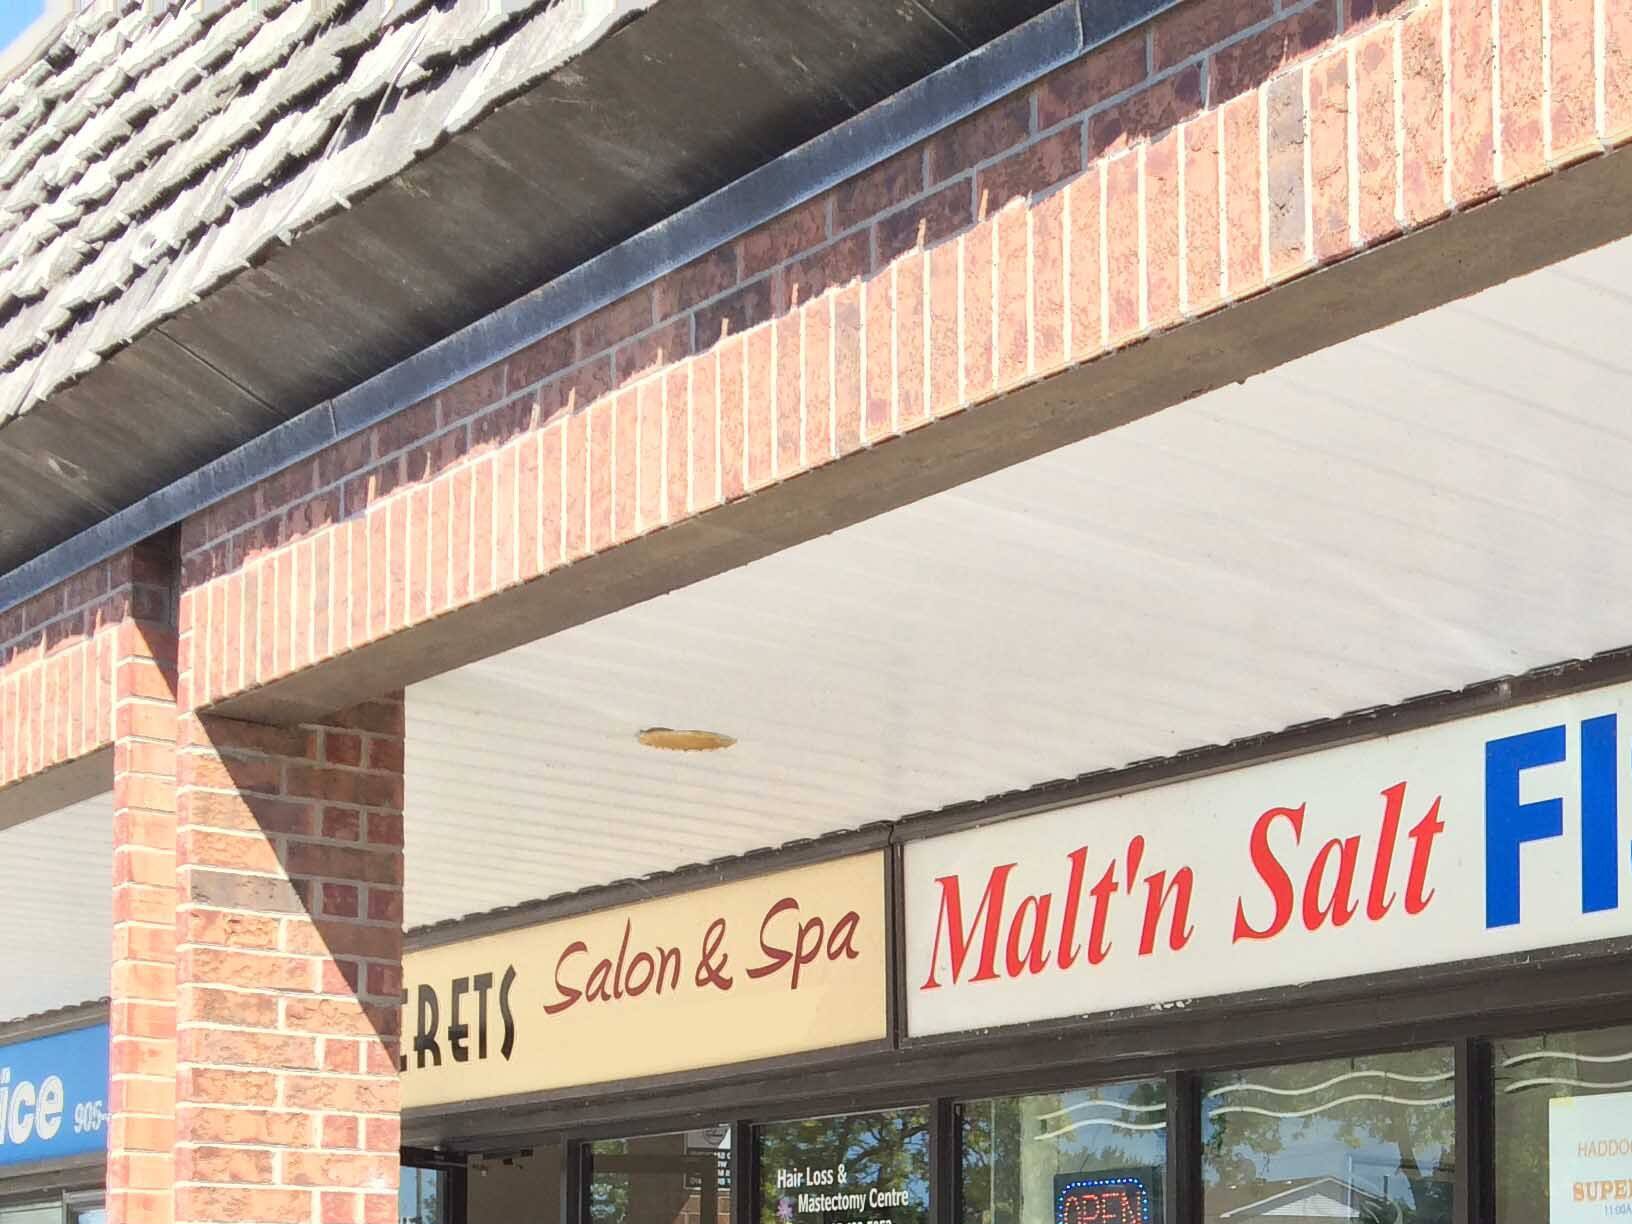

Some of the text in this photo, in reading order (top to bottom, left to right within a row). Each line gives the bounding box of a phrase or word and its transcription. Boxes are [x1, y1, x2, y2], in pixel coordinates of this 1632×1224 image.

[920, 834, 1195, 990] Malt'n
[1232, 781, 1446, 944] Salt
[543, 897, 861, 1014] Salon & Spa
[777, 1163, 847, 1188] Hair Loss &
[798, 1188, 909, 1213] Mastectomy Centre
